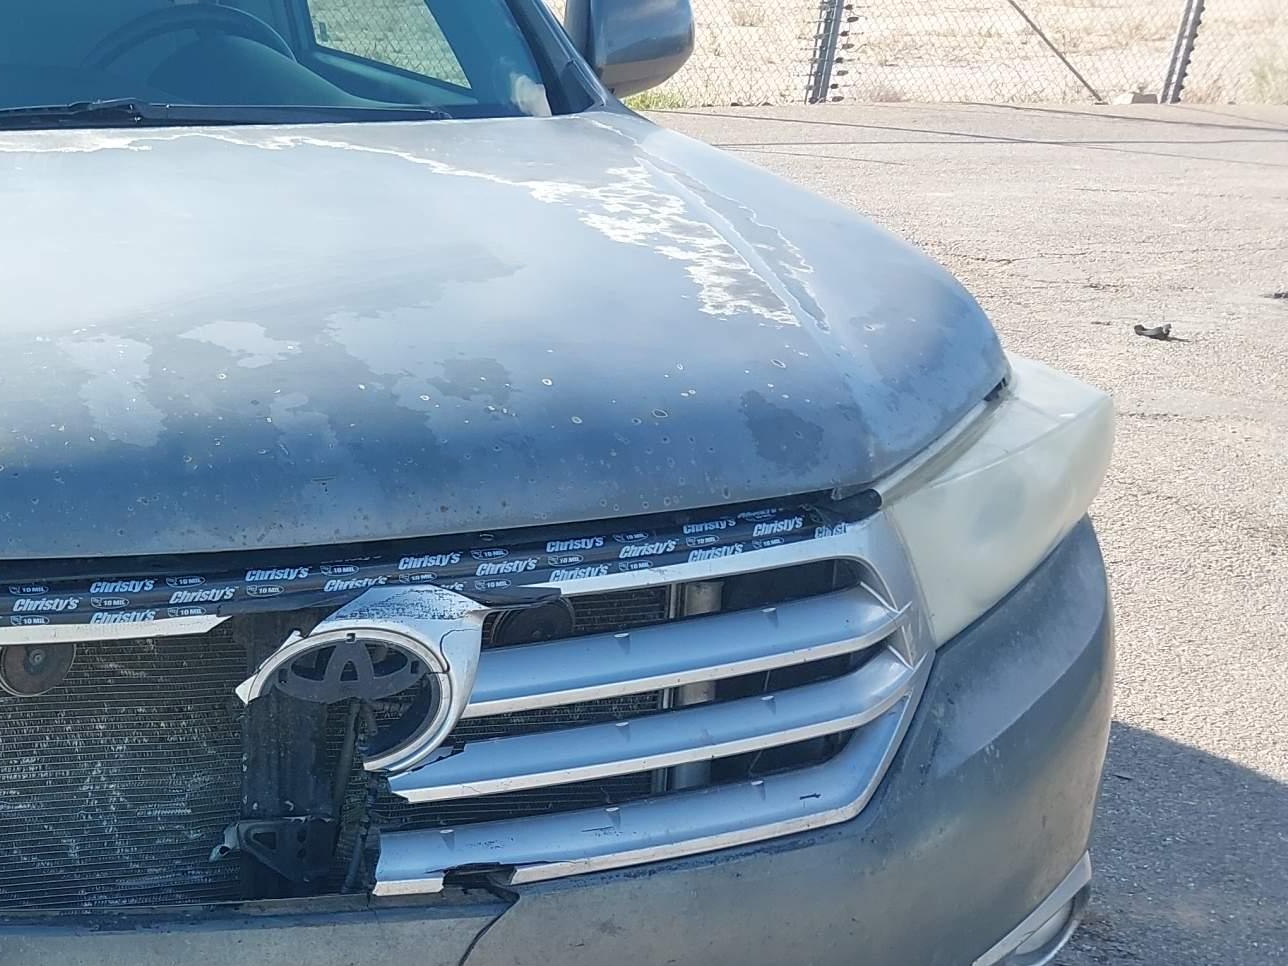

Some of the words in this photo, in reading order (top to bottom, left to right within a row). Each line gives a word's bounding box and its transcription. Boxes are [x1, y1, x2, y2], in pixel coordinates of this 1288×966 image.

[683, 518, 736, 535] Christy's
[753, 516, 804, 537] Christy's
[546, 536, 604, 553] Christy's
[619, 540, 676, 559] Christy's
[688, 543, 743, 563] Christy's
[398, 552, 461, 570] Christy's
[476, 558, 537, 576] Christy's
[245, 566, 309, 582] Christy's
[549, 564, 609, 582] Christy's
[90, 579, 155, 594] Christy's
[169, 587, 235, 604] Christy's
[13, 597, 80, 613] Christy's
[91, 609, 155, 624] Christy's
